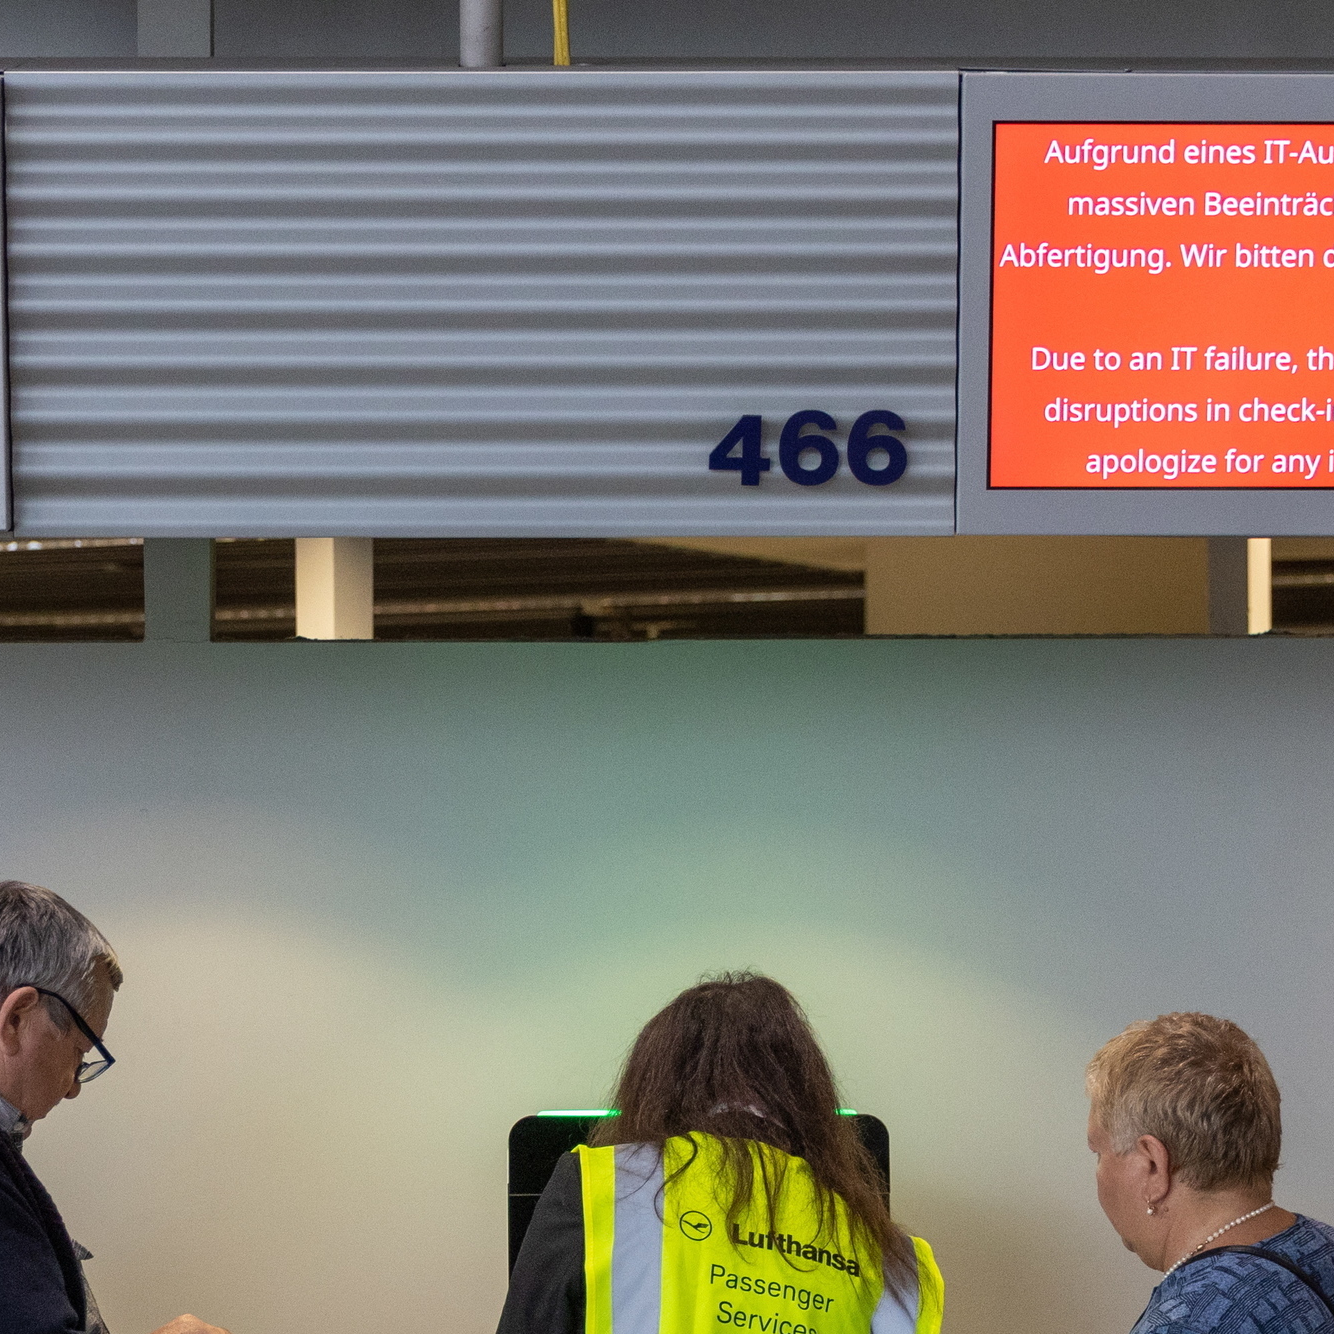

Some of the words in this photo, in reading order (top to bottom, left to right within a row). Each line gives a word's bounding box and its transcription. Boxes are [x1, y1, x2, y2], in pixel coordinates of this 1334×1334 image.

[1044, 139, 1175, 171] Aufgrund
[1184, 140, 1255, 165] eines
[1069, 192, 1195, 217] massiven
[999, 243, 1172, 275] Abfertigung.
[1180, 244, 1227, 268] Wir
[1236, 243, 1314, 269] bitten
[1032, 346, 1085, 371] Due
[1093, 349, 1121, 371] to
[1130, 351, 1163, 371] an
[1170, 346, 1199, 371] IT
[1203, 346, 1298, 374] failure,
[1045, 397, 1198, 429] disruptions
[1207, 398, 1230, 422] in
[708, 408, 908, 486] 466
[1085, 449, 1218, 480] apologize
[1225, 448, 1265, 474] for
[1272, 455, 1322, 480] any
[732, 1223, 861, 1277] Lufthansa
[710, 1264, 835, 1312] Passenger
